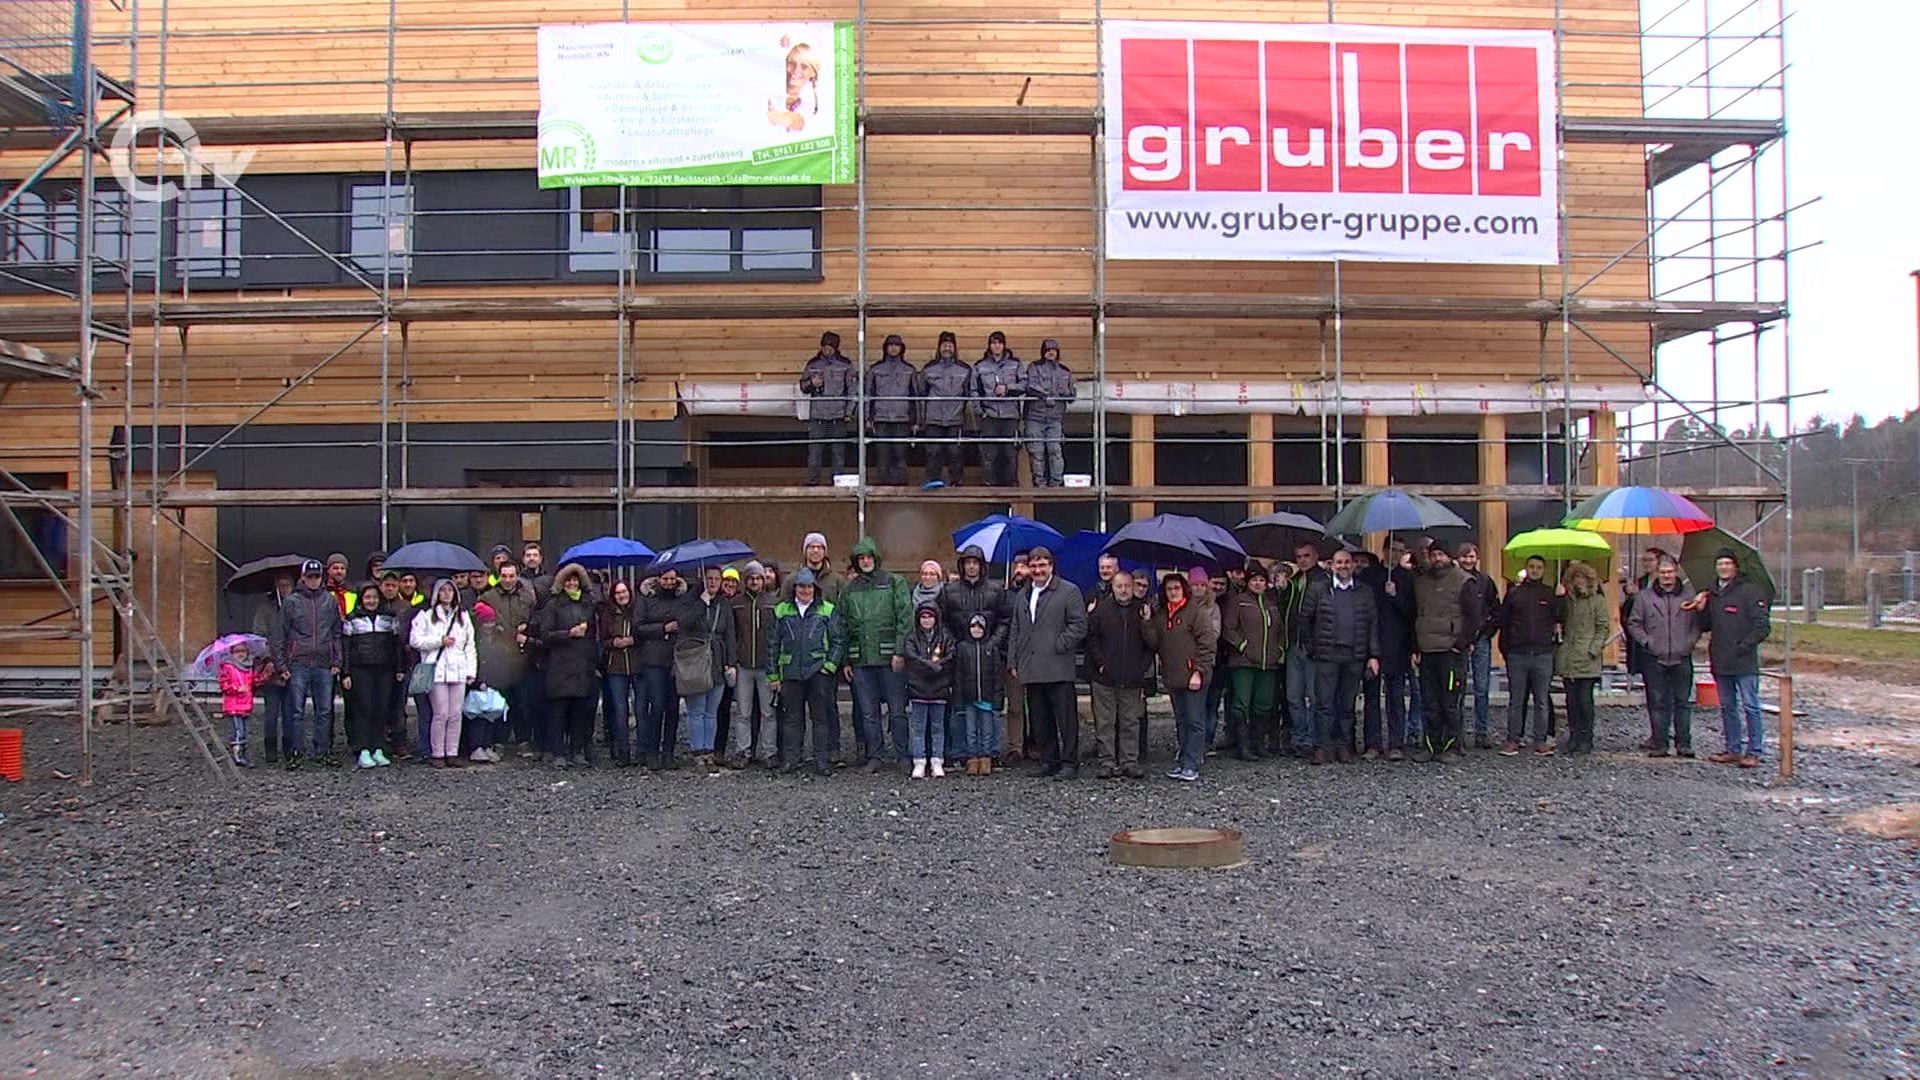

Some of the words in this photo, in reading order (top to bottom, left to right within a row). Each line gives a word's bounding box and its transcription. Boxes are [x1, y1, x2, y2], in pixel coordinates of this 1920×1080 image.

[1127, 52, 1532, 182] gruber
[541, 146, 577, 170] MR
[756, 150, 773, 161] Tel.
[1126, 203, 1539, 240] www.gruber-gruppe.com
